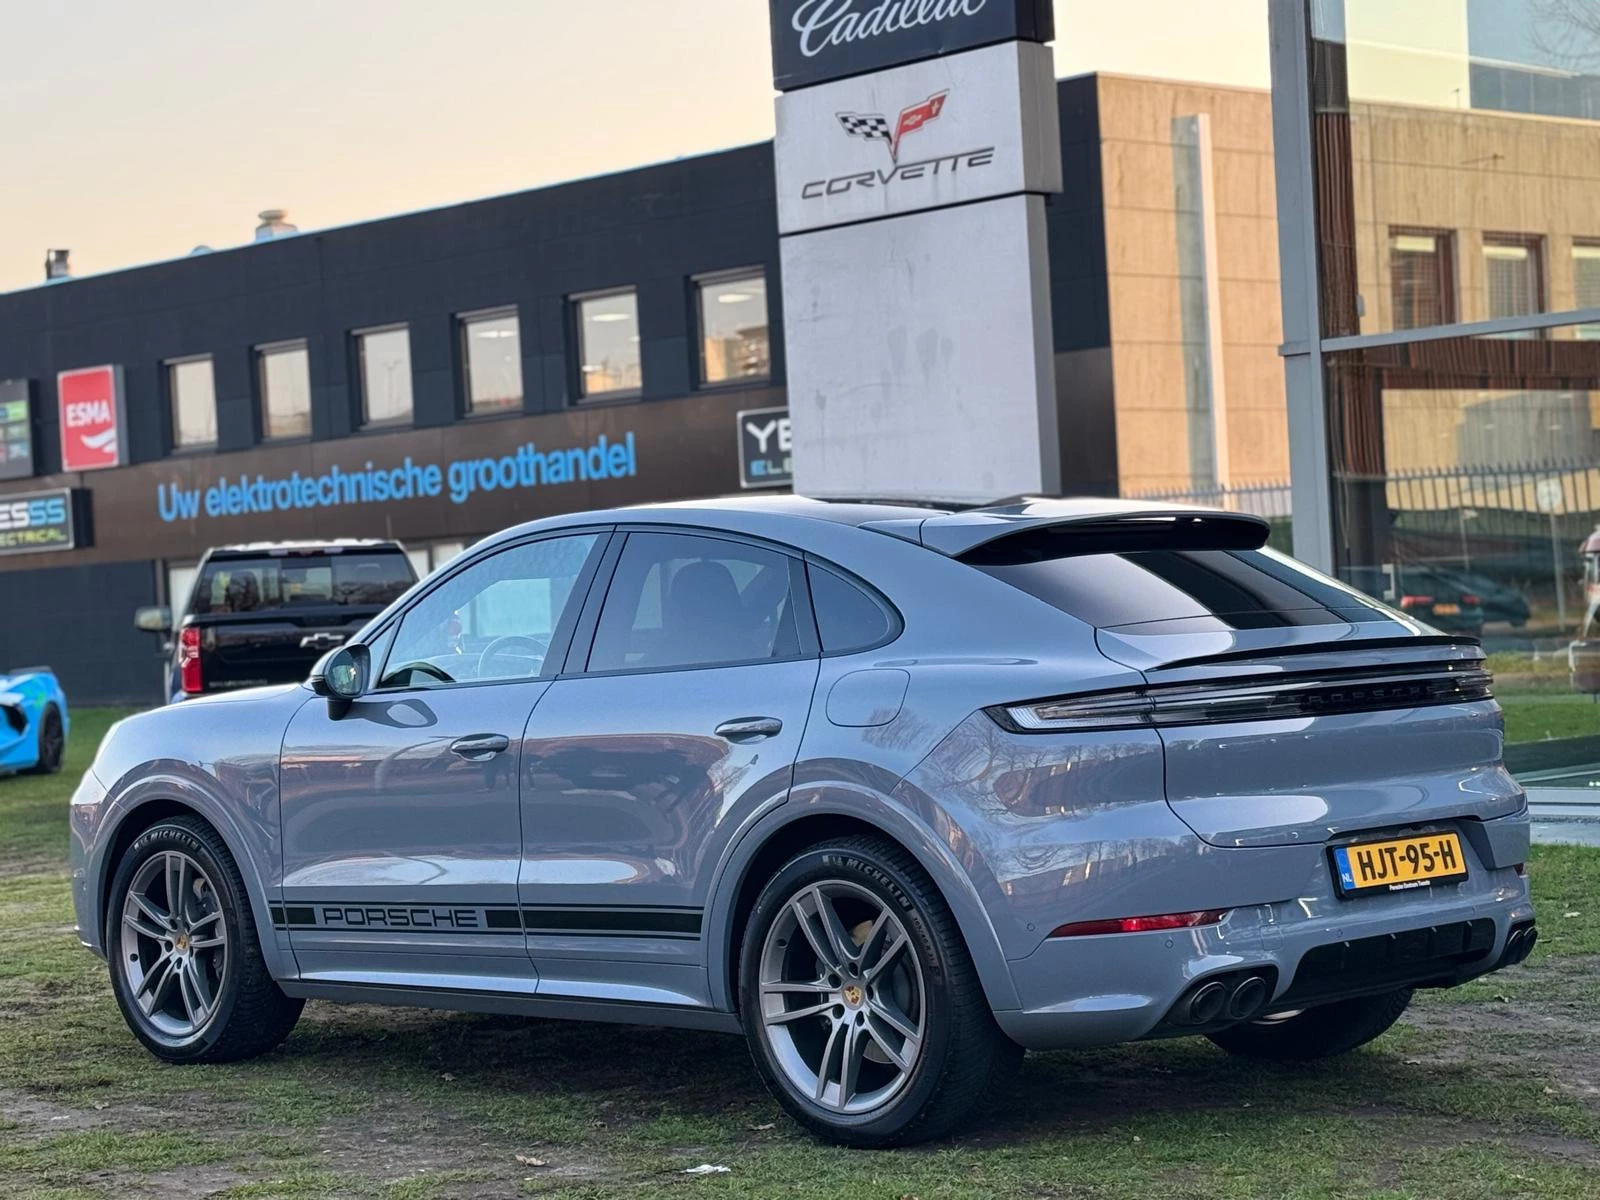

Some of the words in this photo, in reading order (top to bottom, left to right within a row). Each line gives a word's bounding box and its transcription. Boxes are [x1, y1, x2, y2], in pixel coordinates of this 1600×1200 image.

[801, 146, 995, 200] CORVETTE
[66, 400, 111, 428] ESMA
[157, 483, 200, 522] Uw
[204, 456, 442, 518] elektrotechnische
[448, 431, 636, 505] groothandel
[150, 830, 201, 851] MICHELIN
[1341, 872, 1353, 884] NL
[1356, 839, 1457, 882] HJT-95-H
[847, 859, 910, 910] MICHELIN
[321, 907, 479, 928] PORSCHE
